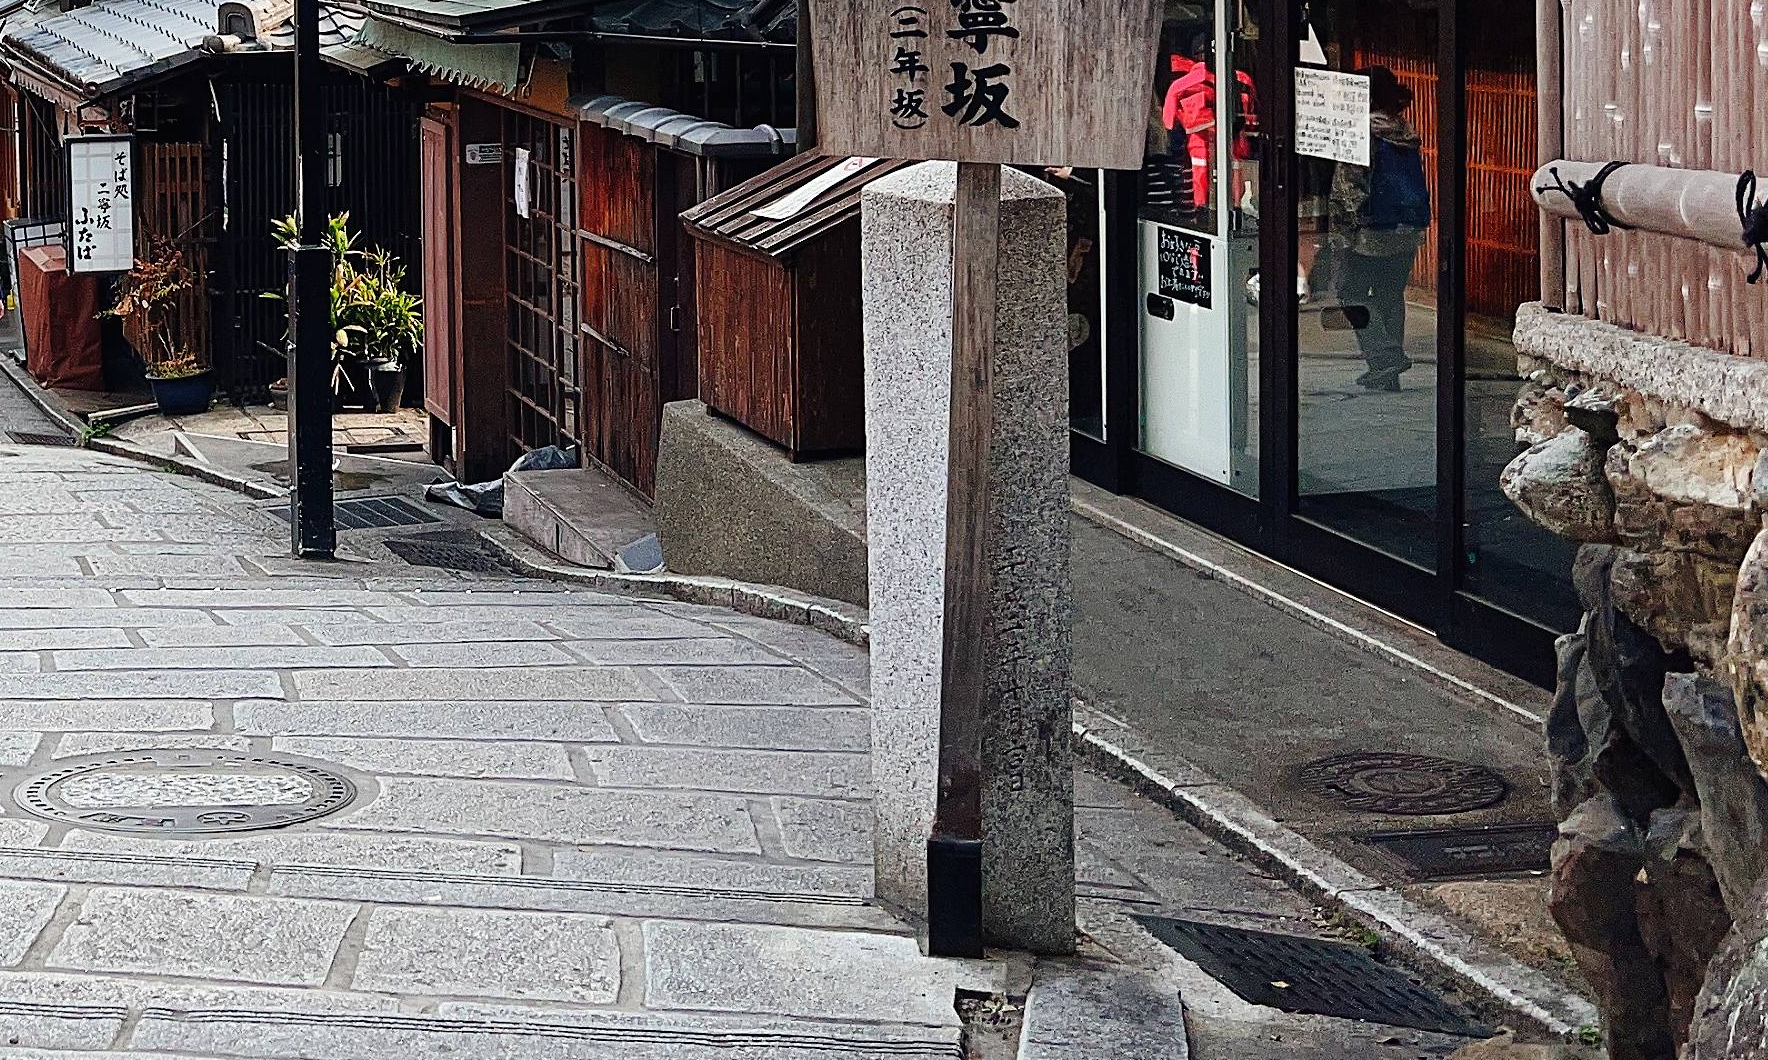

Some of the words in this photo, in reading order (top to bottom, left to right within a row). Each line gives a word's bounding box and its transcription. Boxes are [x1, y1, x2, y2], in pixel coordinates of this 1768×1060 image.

[113, 151, 130, 200] そば処
[75, 206, 97, 260] ふたば
